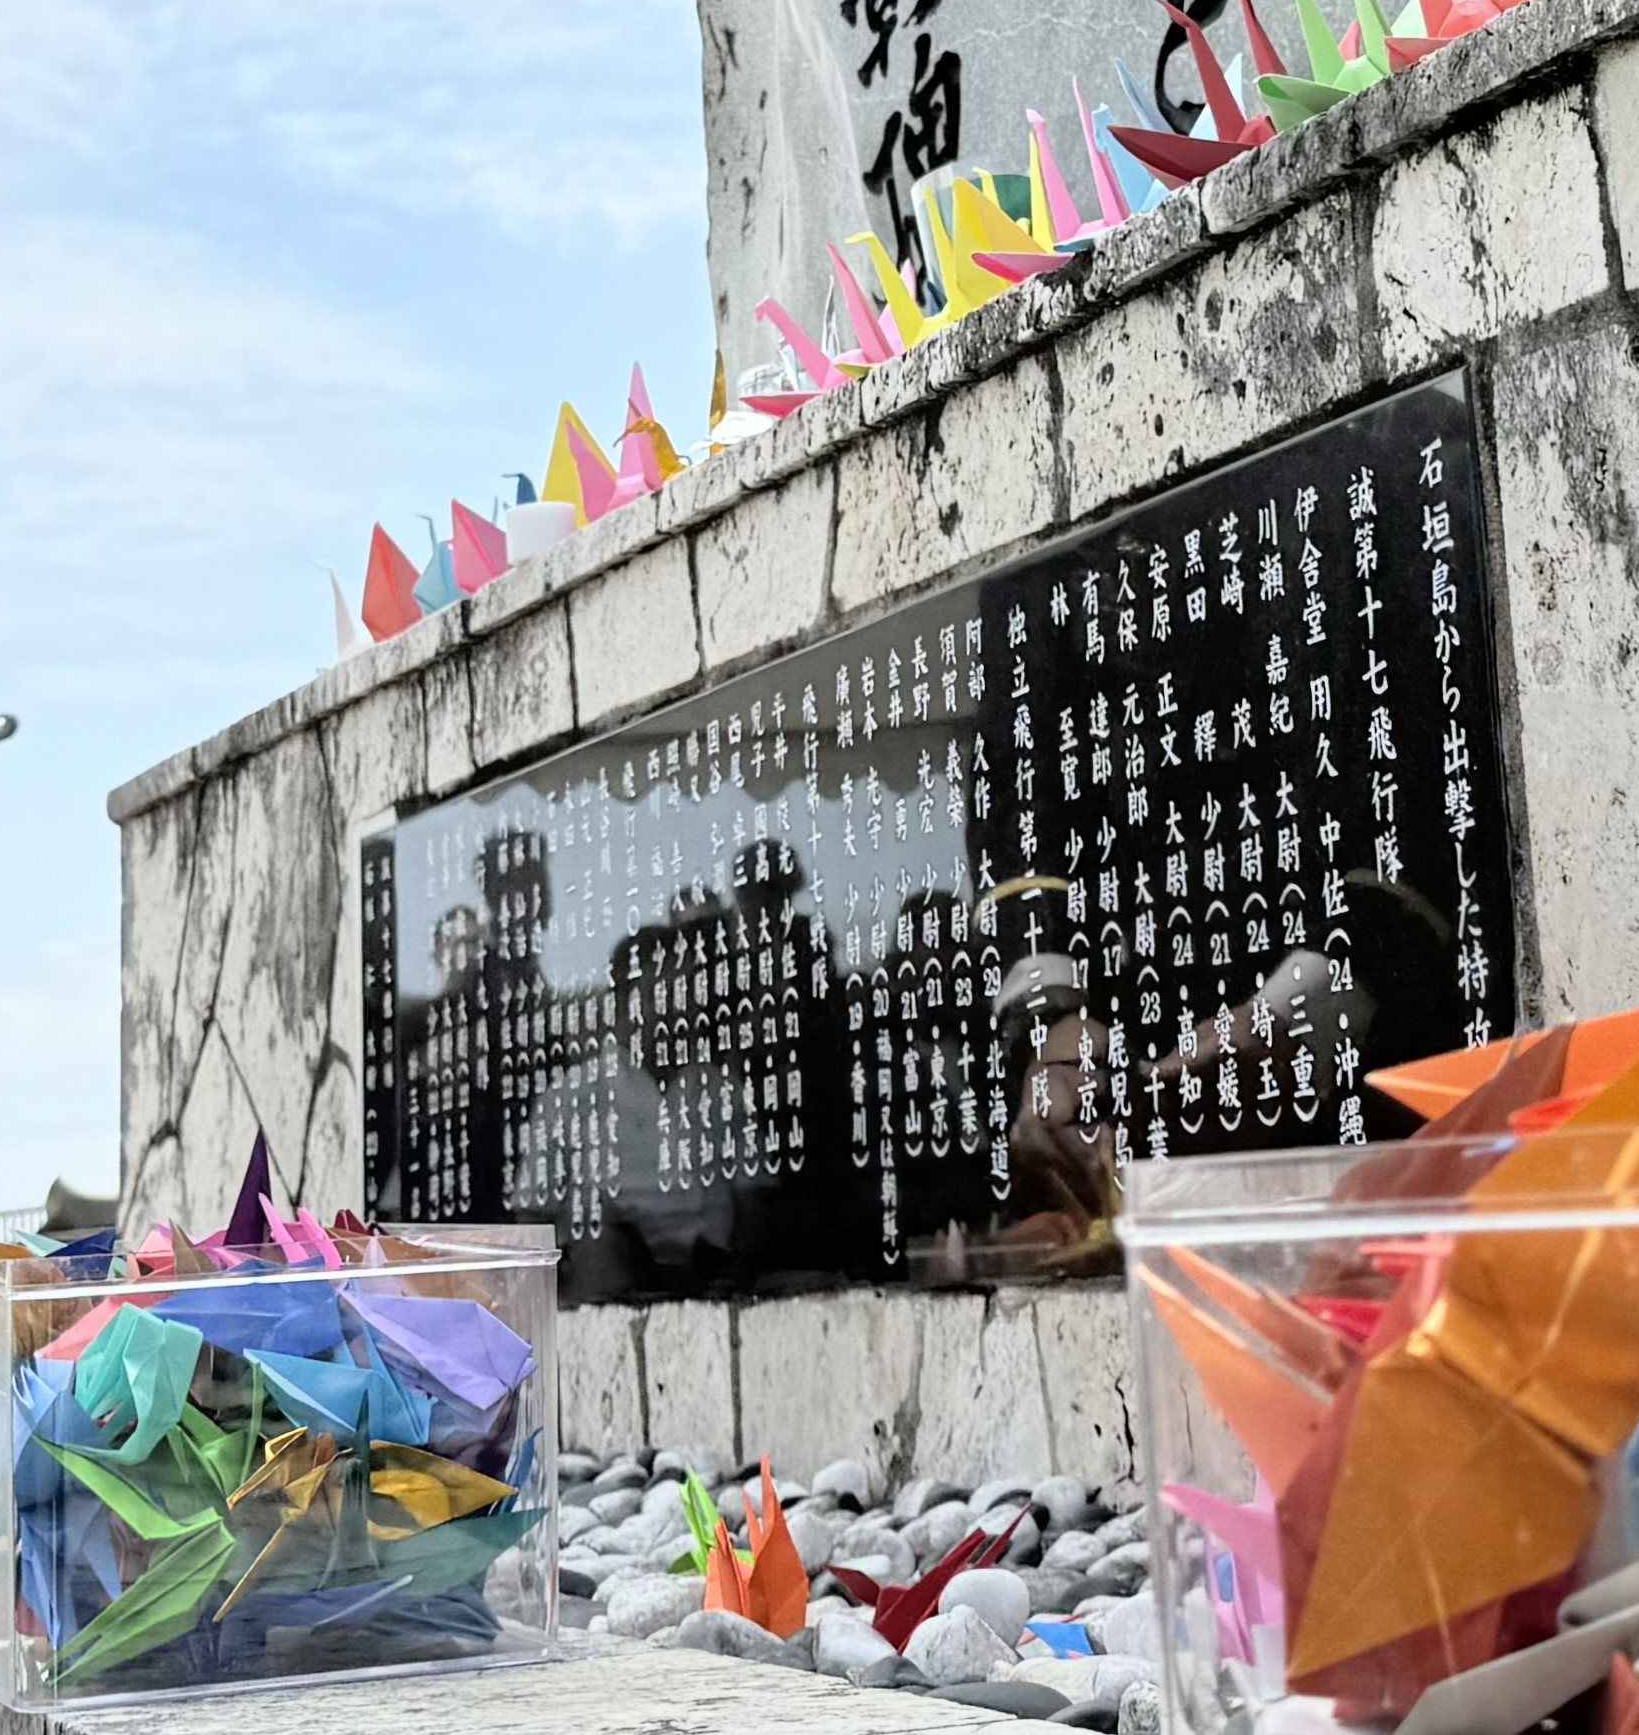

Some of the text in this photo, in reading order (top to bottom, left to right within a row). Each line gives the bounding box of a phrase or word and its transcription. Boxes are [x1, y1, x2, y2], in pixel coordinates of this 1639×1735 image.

[1147, 543, 1172, 643] 安原
[1183, 528, 1207, 624] 黒田
[1218, 511, 1245, 615] 芝崎
[1258, 498, 1285, 602] 川瀬
[1050, 582, 1070, 626] 林
[1082, 569, 1105, 664] 有馬
[1116, 558, 1139, 653] 久保
[1293, 485, 1327, 646] 伊舎堂
[1310, 674, 1339, 779] 用久
[861, 656, 878, 741] 岩本
[888, 647, 904, 728] 金井
[911, 634, 930, 721] 長野
[966, 617, 985, 701] 阿部
[1265, 633, 1295, 736] 嘉紀
[1346, 466, 1405, 885] 誠第十七飛行隊
[771, 691, 788, 770] 平井
[1089, 692, 1112, 786] 達郎
[1122, 682, 1149, 827] 元治郎
[1157, 671, 1182, 768] 正文
[1231, 697, 1256, 750] 茂
[973, 732, 991, 820] 久作
